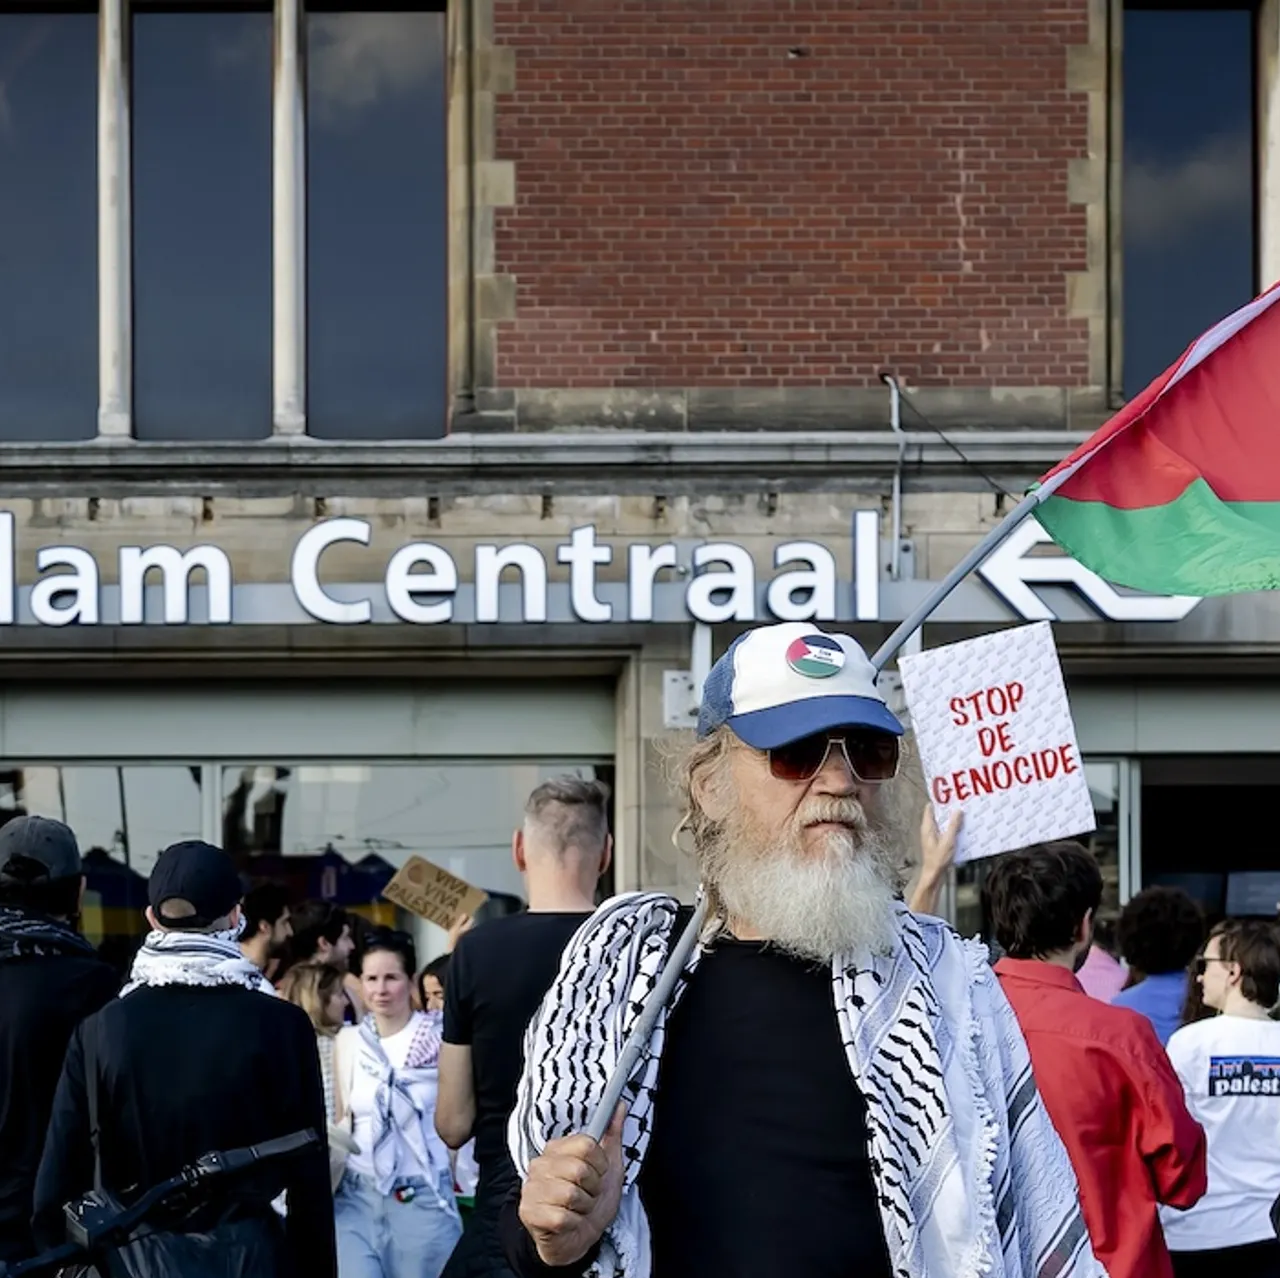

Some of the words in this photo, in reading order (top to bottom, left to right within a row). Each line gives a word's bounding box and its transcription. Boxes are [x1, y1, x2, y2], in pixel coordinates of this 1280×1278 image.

[291, 511, 879, 624] Centraal
[949, 681, 1024, 726] STOP
[977, 721, 1016, 757] DE
[932, 743, 1080, 804] GENOCIDE
[384, 882, 457, 929] PALESTIN
[424, 881, 460, 913] VIVA
[435, 869, 470, 899] VIVA
